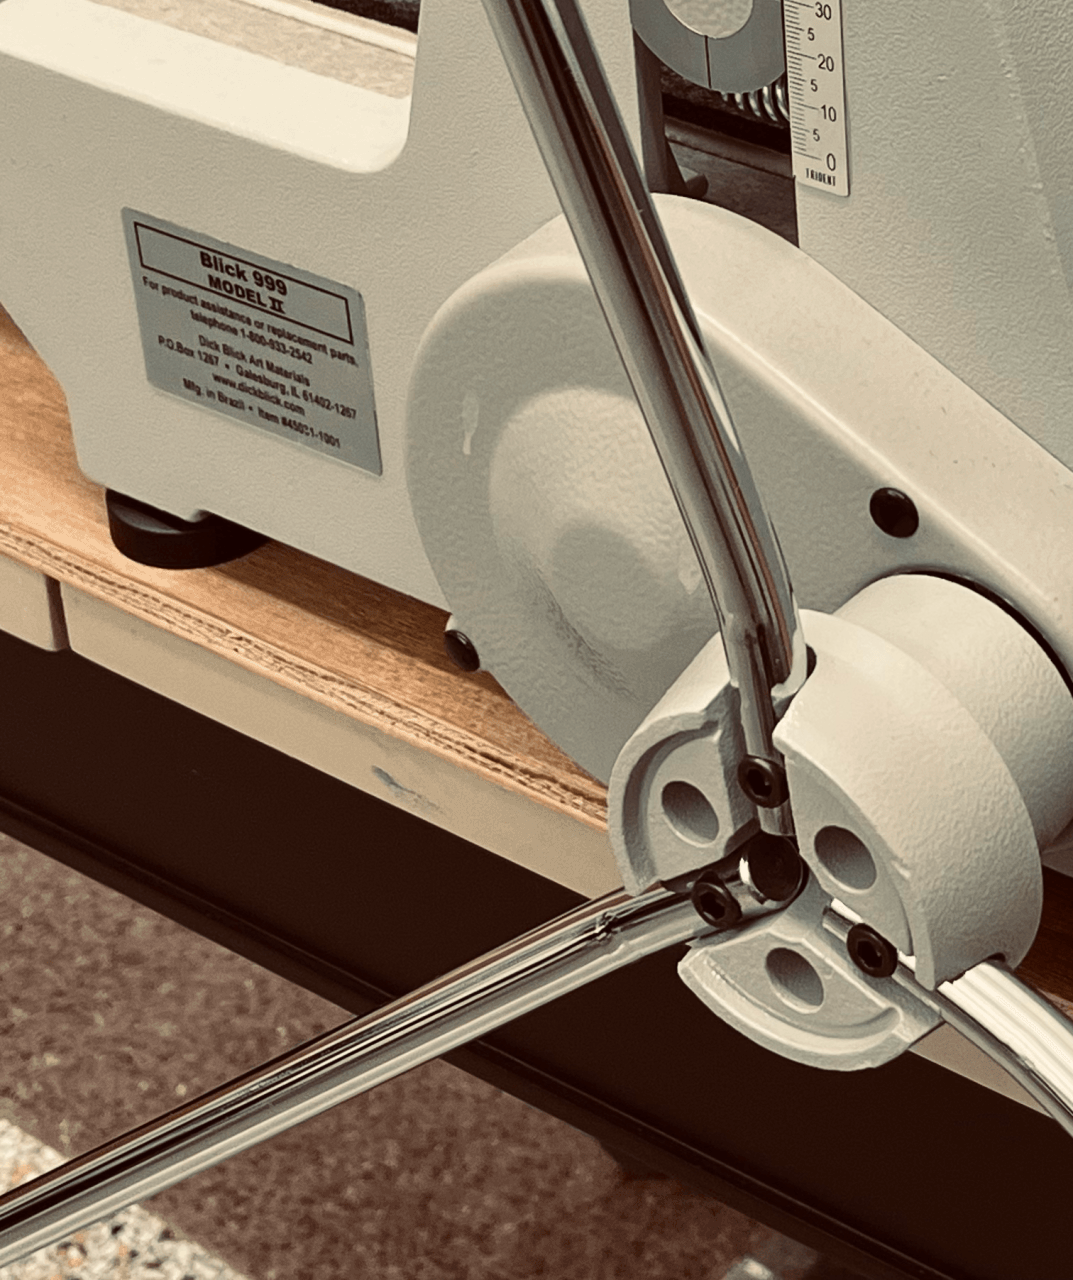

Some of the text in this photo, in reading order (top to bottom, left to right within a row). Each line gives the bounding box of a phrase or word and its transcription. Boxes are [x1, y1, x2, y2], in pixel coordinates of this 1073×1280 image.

[815, 1, 832, 21] 30
[807, 27, 815, 41] 5
[817, 53, 835, 72] 20
[810, 79, 818, 93] 5
[821, 104, 837, 122] 10
[813, 129, 821, 142] 5
[826, 152, 836, 171] 0
[806, 168, 836, 186] TRIDENT
[200, 251, 287, 295] Blick 999
[208, 274, 286, 314] MODEL II
[142, 276, 358, 368] For product assistance or replacement parts.
[190, 309, 313, 364] telephone 1-800-933-2542
[198, 334, 311, 387] Dick Blick Art Materials
[182, 377, 203, 399] Mfg.
[206, 384, 216, 399] in
[217, 389, 245, 412] Brazil
[258, 406, 280, 424] Item
[212, 373, 305, 416] www.dickblick.com
[291, 383, 301, 399] IL
